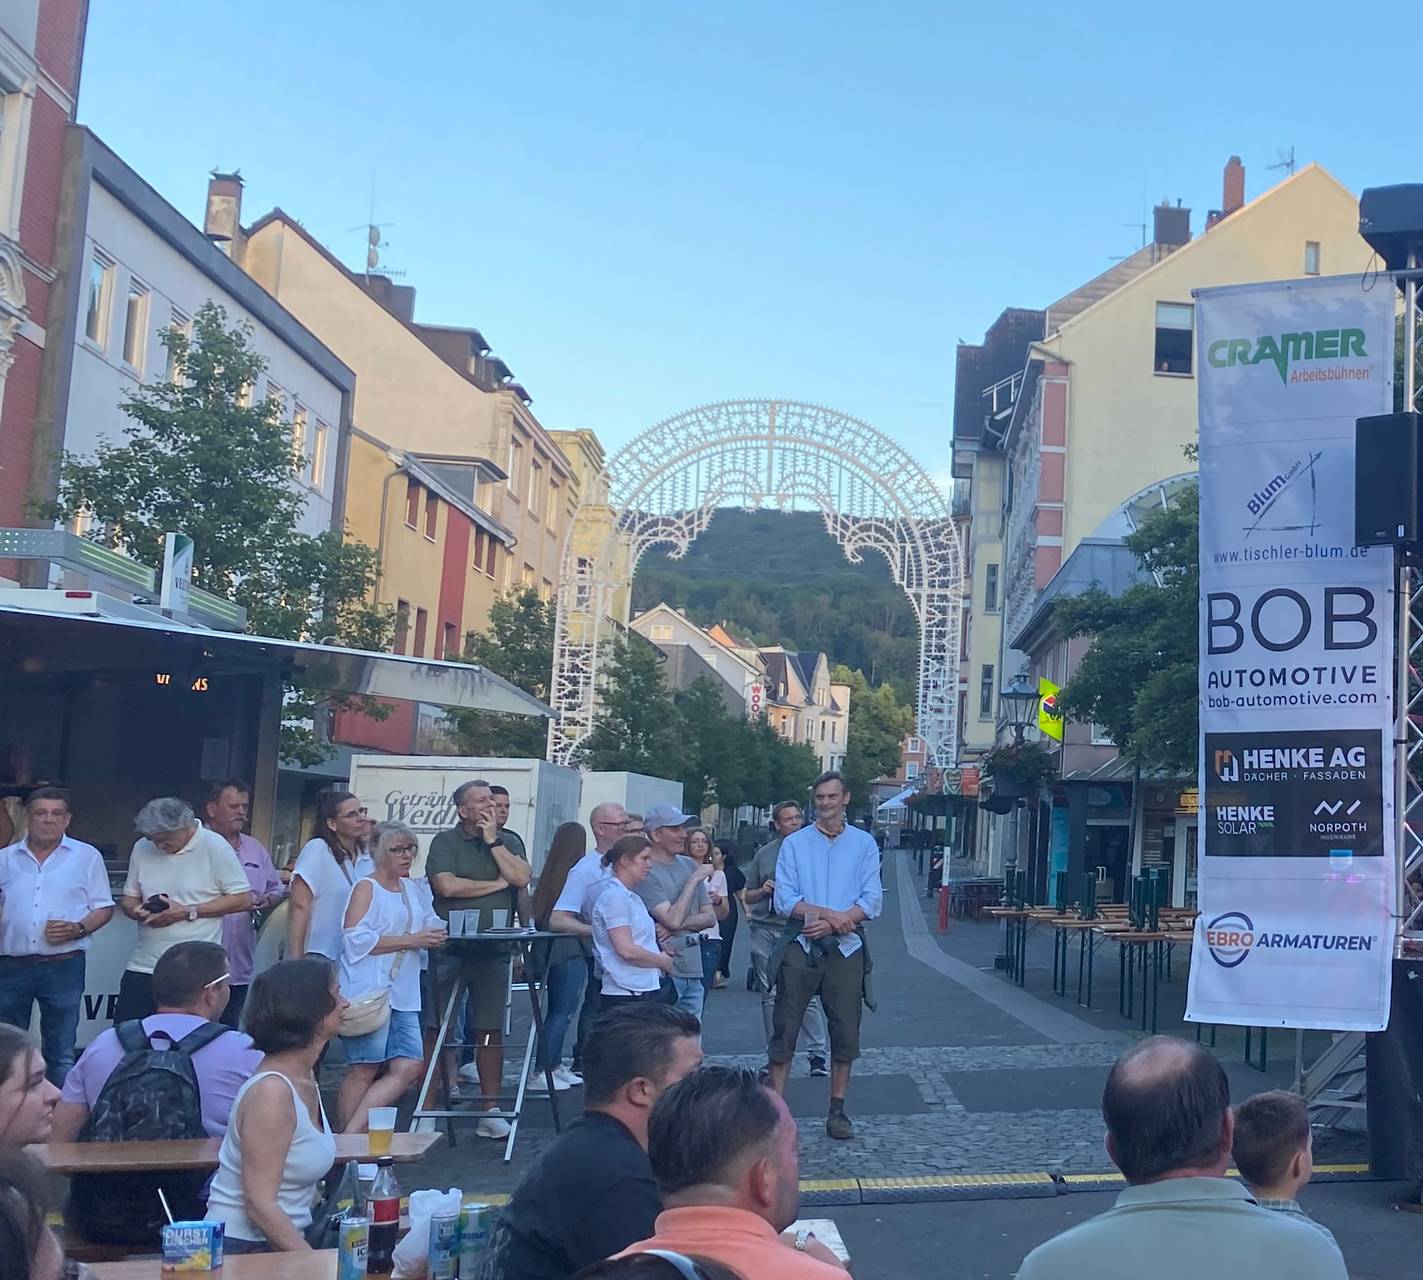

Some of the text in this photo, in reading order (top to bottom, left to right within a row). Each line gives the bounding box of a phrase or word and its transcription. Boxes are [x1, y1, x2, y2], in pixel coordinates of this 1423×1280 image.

[1207, 328, 1368, 388] CRAMER
[1290, 366, 1369, 384] Arbeitsbühnen
[1247, 475, 1287, 515] Blum
[1214, 544, 1369, 563] www.tischler-blum.de
[1207, 587, 1378, 655] BOB
[1208, 666, 1377, 689] AUTOMOTIVE
[1208, 691, 1377, 708] bob-automotive.com
[1243, 746, 1366, 769] HENKE AG
[1243, 770, 1366, 782] DÄCHER FASSADEN
[1216, 806, 1275, 822] HENKE
[1217, 821, 1257, 835] SOLAR
[1309, 822, 1368, 833] NORPOTH
[1206, 931, 1254, 947] EBRO
